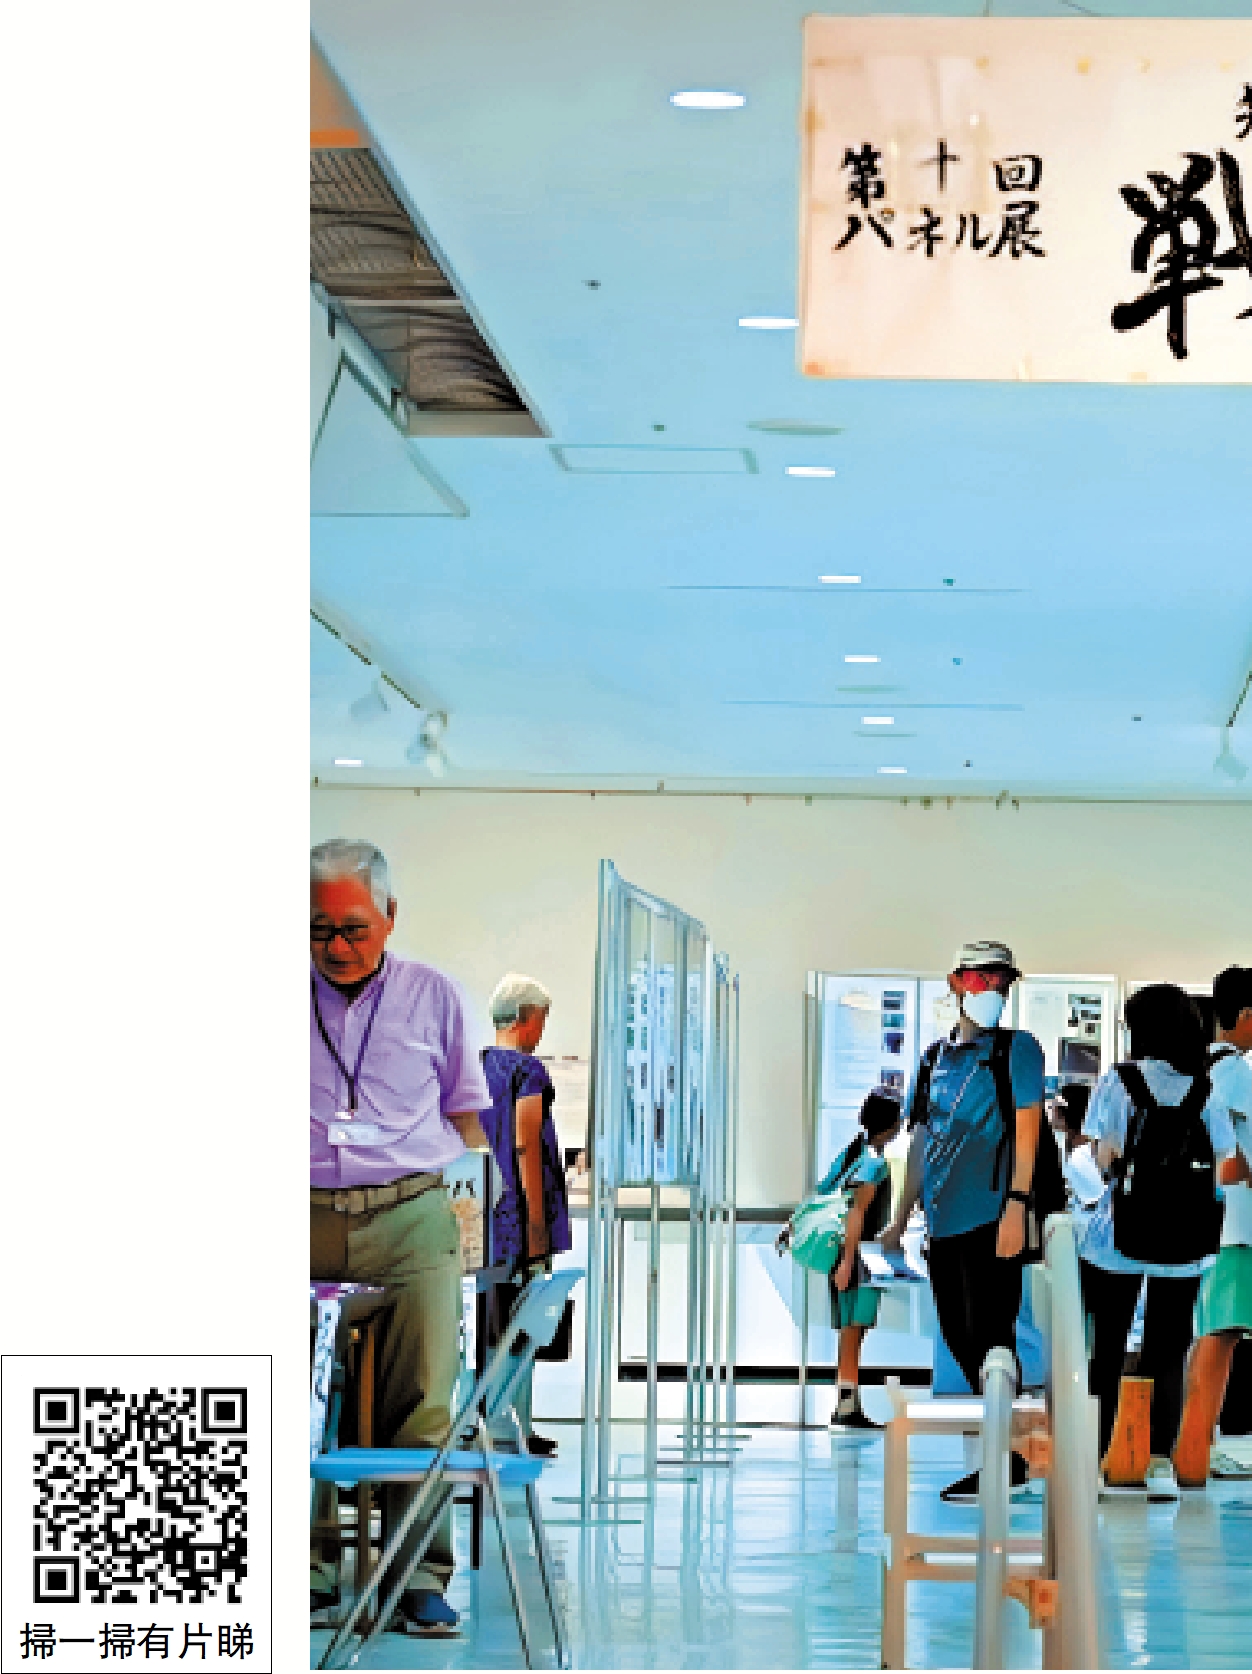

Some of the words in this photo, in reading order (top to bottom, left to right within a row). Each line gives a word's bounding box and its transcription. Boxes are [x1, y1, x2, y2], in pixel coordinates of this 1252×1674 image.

[840, 138, 1044, 209] 第十回
[833, 201, 1047, 258] パネル展
